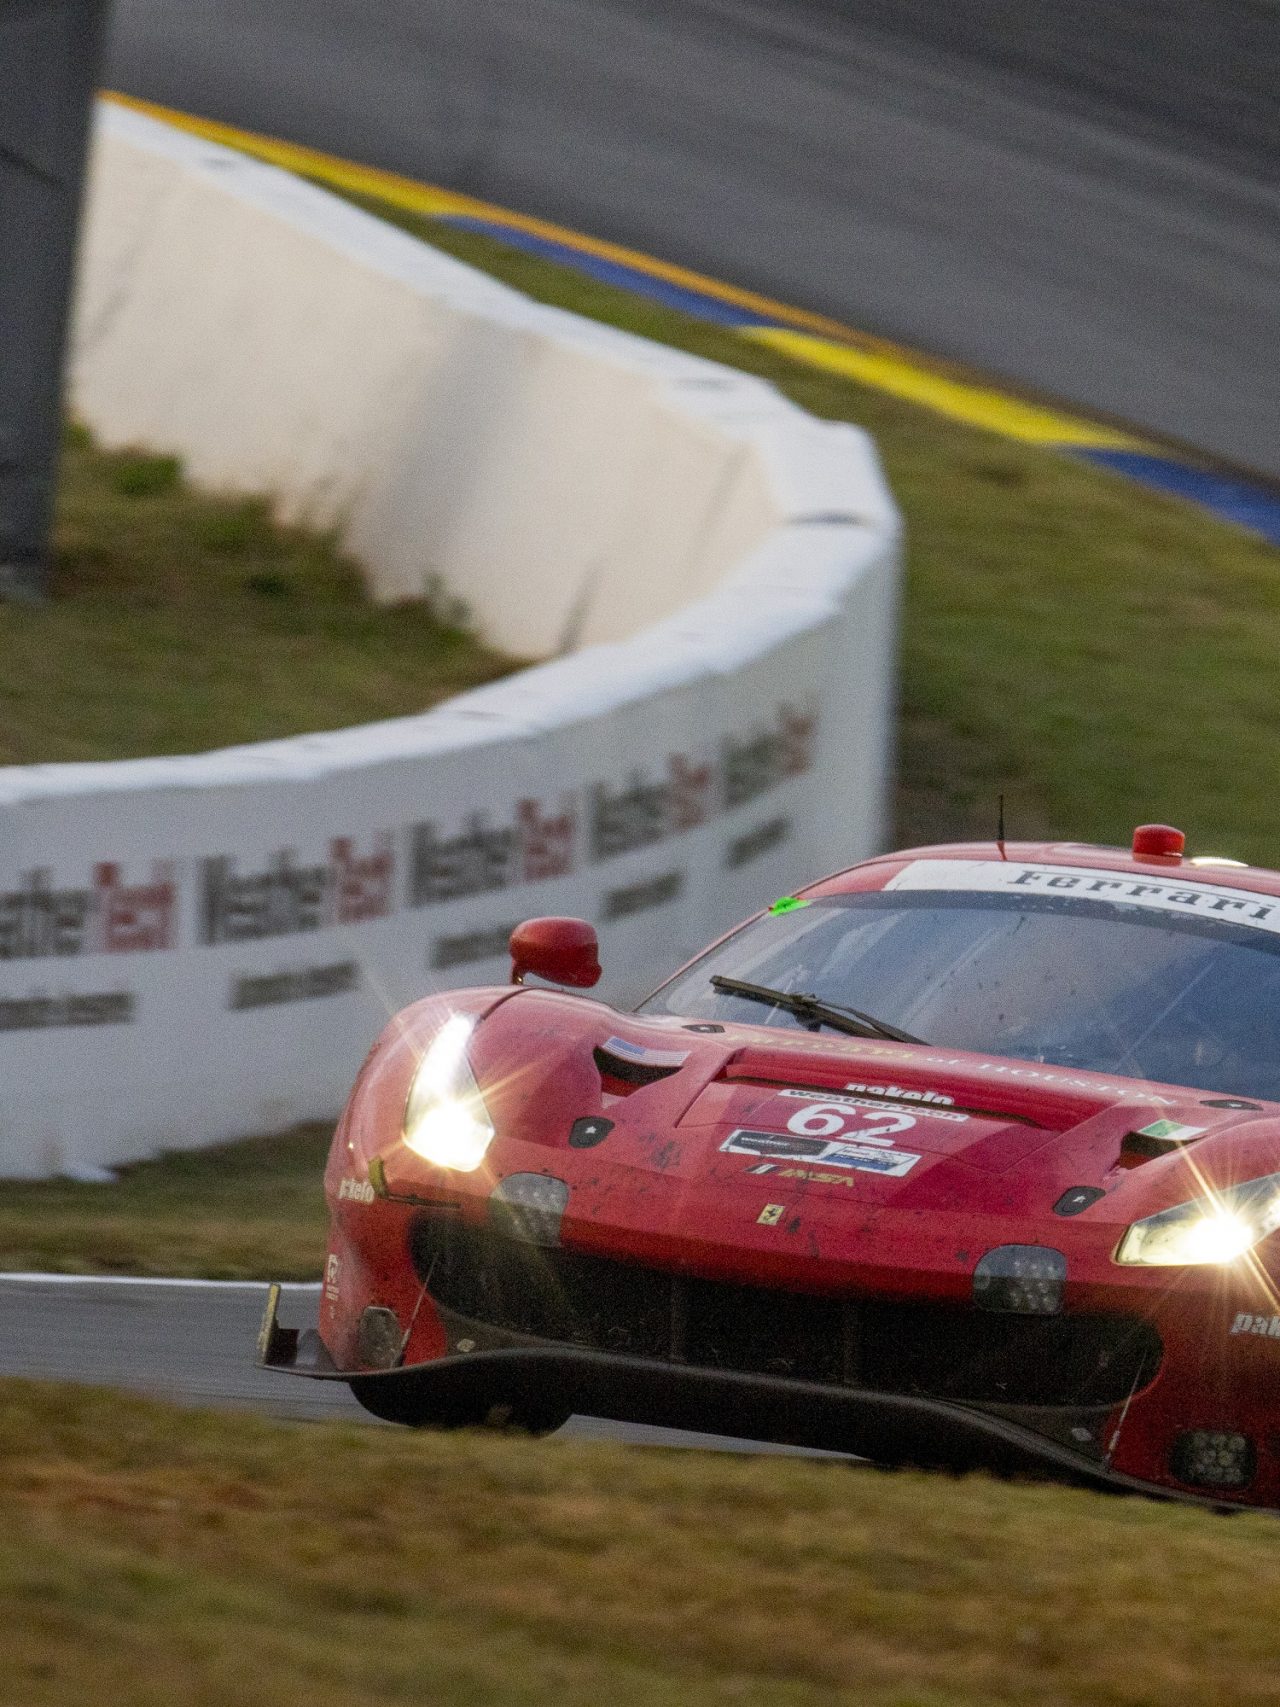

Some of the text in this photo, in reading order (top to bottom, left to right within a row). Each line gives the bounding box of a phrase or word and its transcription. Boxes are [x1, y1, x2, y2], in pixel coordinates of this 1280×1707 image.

[1006, 870, 1277, 921] Ferrari
[786, 1102, 917, 1147] 62
[788, 1089, 966, 1120] WeatherTech
